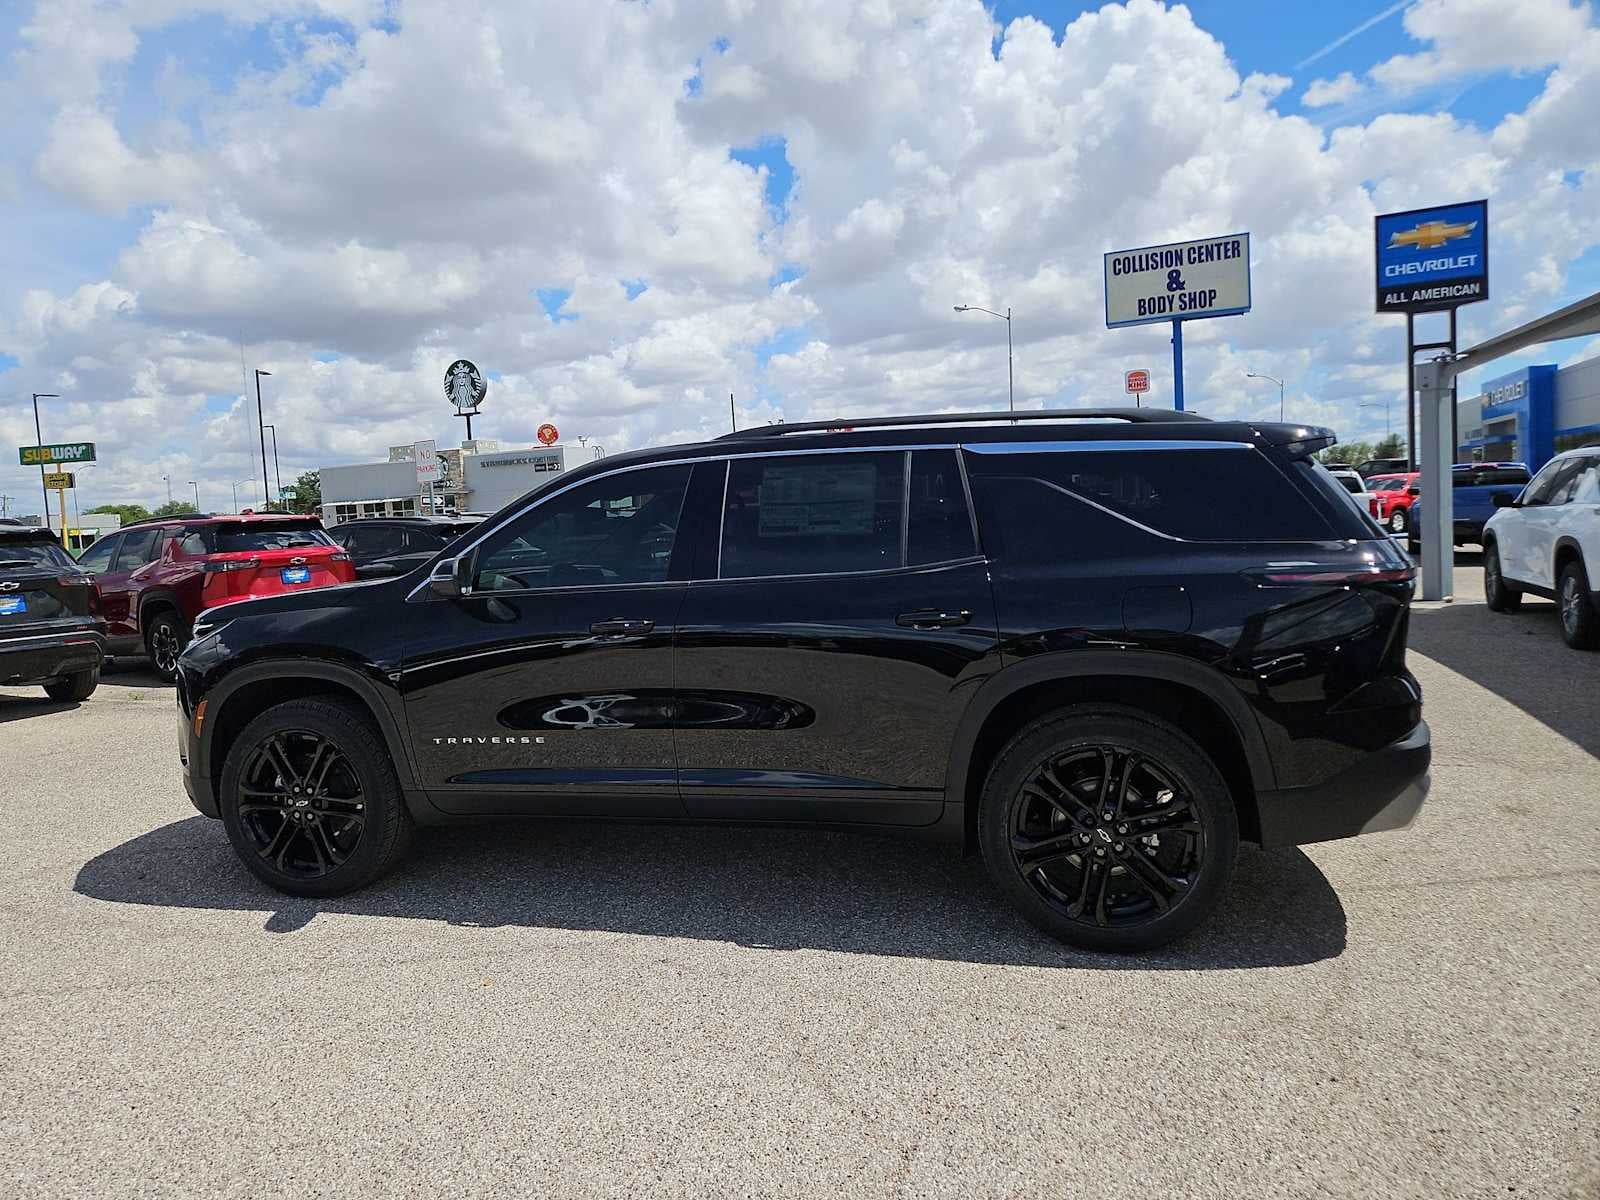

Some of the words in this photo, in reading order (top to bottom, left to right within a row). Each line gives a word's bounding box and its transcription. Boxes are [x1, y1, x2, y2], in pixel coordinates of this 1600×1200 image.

[1112, 249, 1184, 276] COLLISION
[1187, 240, 1241, 265] CENTER
[1385, 254, 1478, 277] CHEVROLET
[1166, 269, 1186, 292] &
[1137, 294, 1175, 316] BODY
[1178, 289, 1217, 311] SHOP
[1384, 292, 1409, 305] ALL
[1411, 283, 1480, 301] AMERICAN
[23, 446, 86, 462] SUBWAY
[420, 449, 431, 459] NO
[433, 736, 545, 745] TRAVERSE
